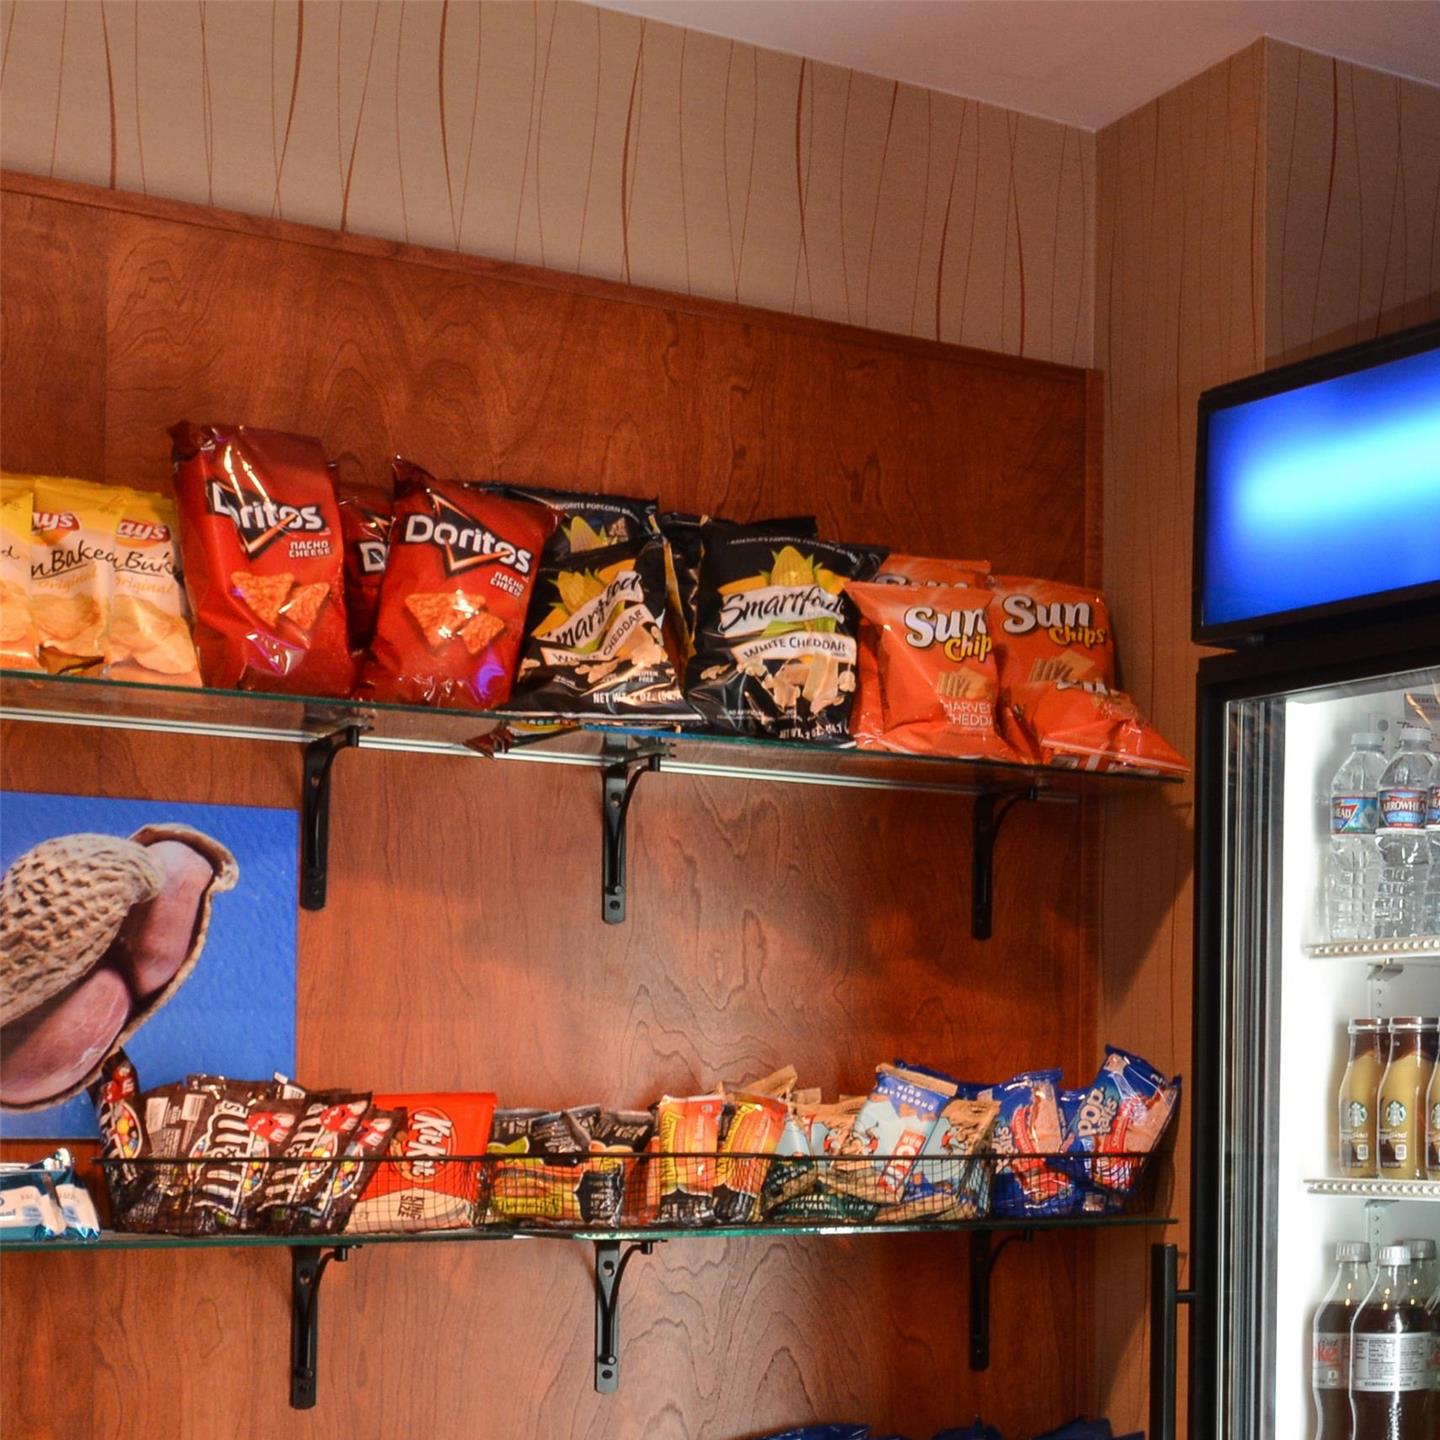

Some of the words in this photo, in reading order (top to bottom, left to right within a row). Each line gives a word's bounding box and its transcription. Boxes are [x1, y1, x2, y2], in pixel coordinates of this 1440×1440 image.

[289, 540, 330, 550] NACHO
[405, 514, 532, 574] Doritos
[1002, 594, 1091, 635] Sun
[904, 606, 987, 649] Sun
[1049, 625, 1107, 647] Chips
[743, 638, 787, 659] WHITE
[788, 636, 847, 652] CHEDDAR
[944, 631, 992, 662] Chip
[944, 702, 992, 715] HARVES
[1383, 800, 1426, 813] ARROWHEA
